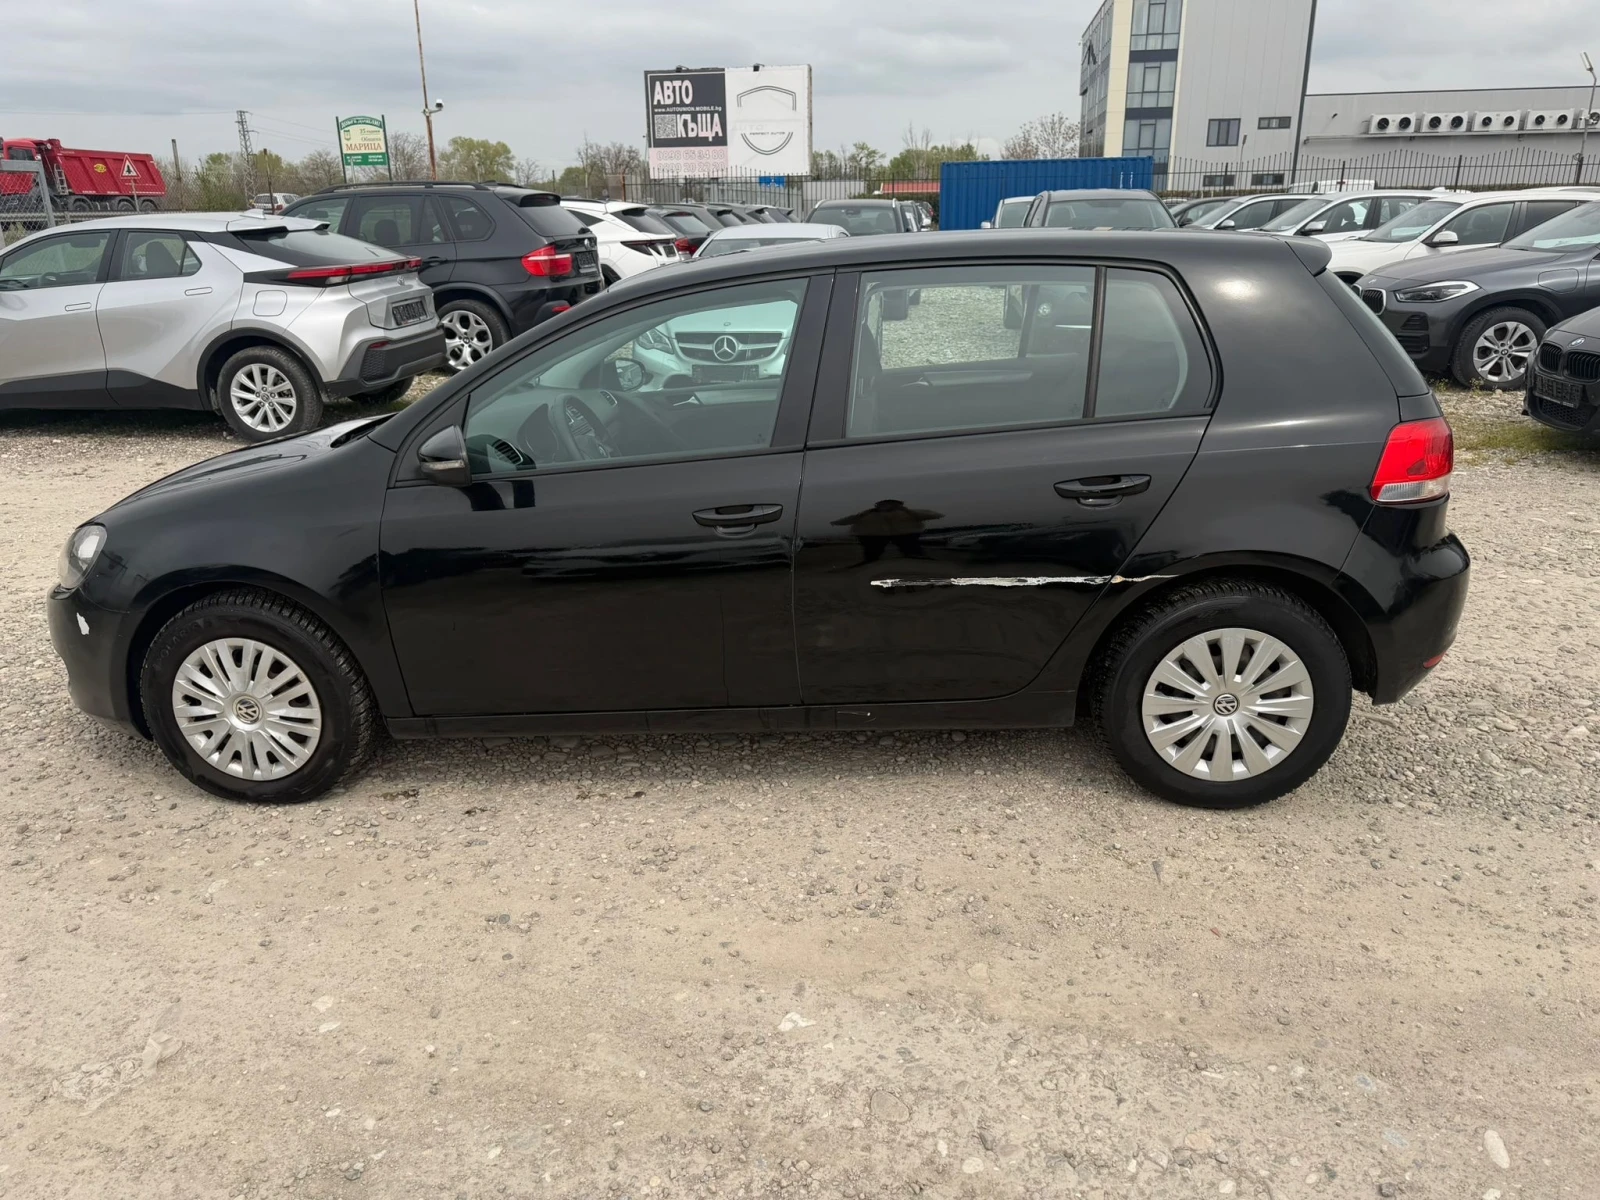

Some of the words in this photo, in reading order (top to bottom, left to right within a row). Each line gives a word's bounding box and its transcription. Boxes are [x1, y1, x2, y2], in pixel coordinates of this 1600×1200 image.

[653, 80, 693, 105] АВТО
[677, 113, 723, 142] КЪЩА
[345, 143, 382, 151] МАРИЦА
